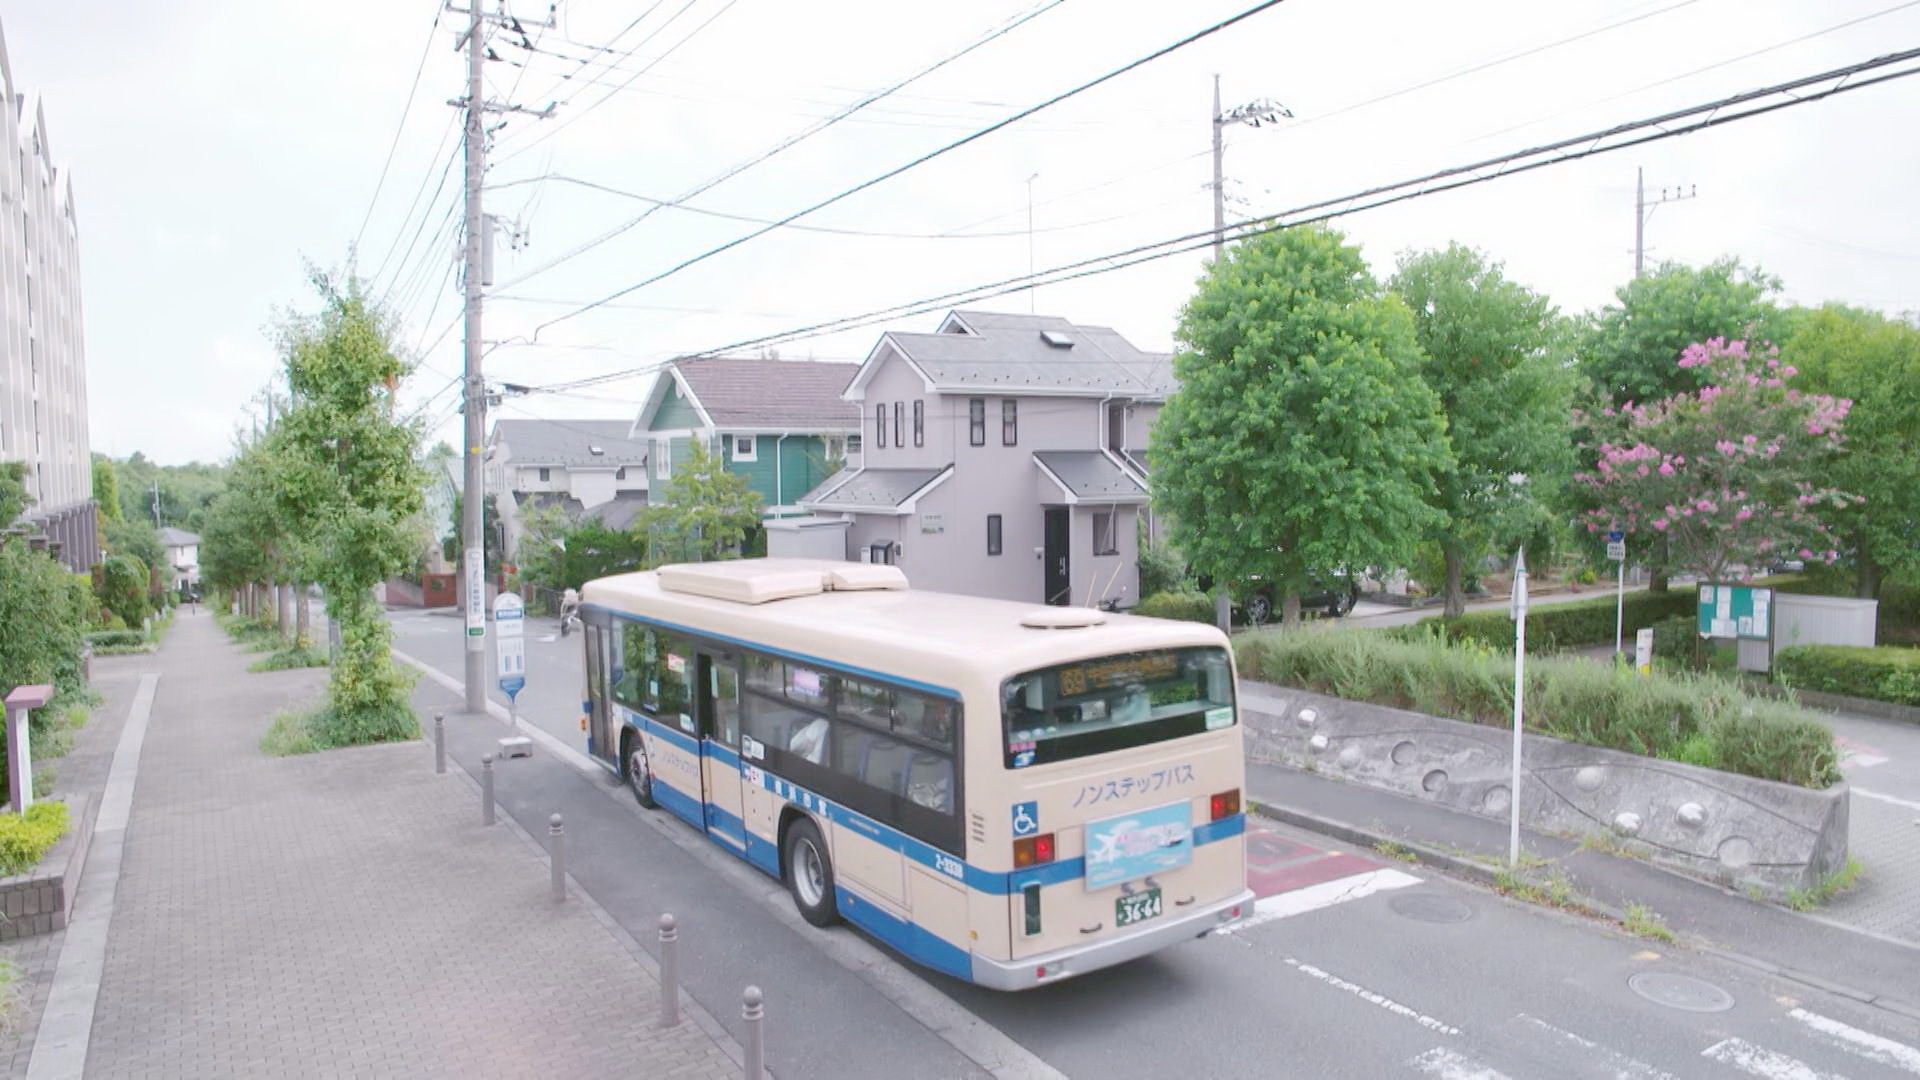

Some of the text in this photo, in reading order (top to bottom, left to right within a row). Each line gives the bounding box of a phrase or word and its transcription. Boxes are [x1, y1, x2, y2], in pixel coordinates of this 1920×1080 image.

[1073, 764, 1194, 806] ノンステップバス
